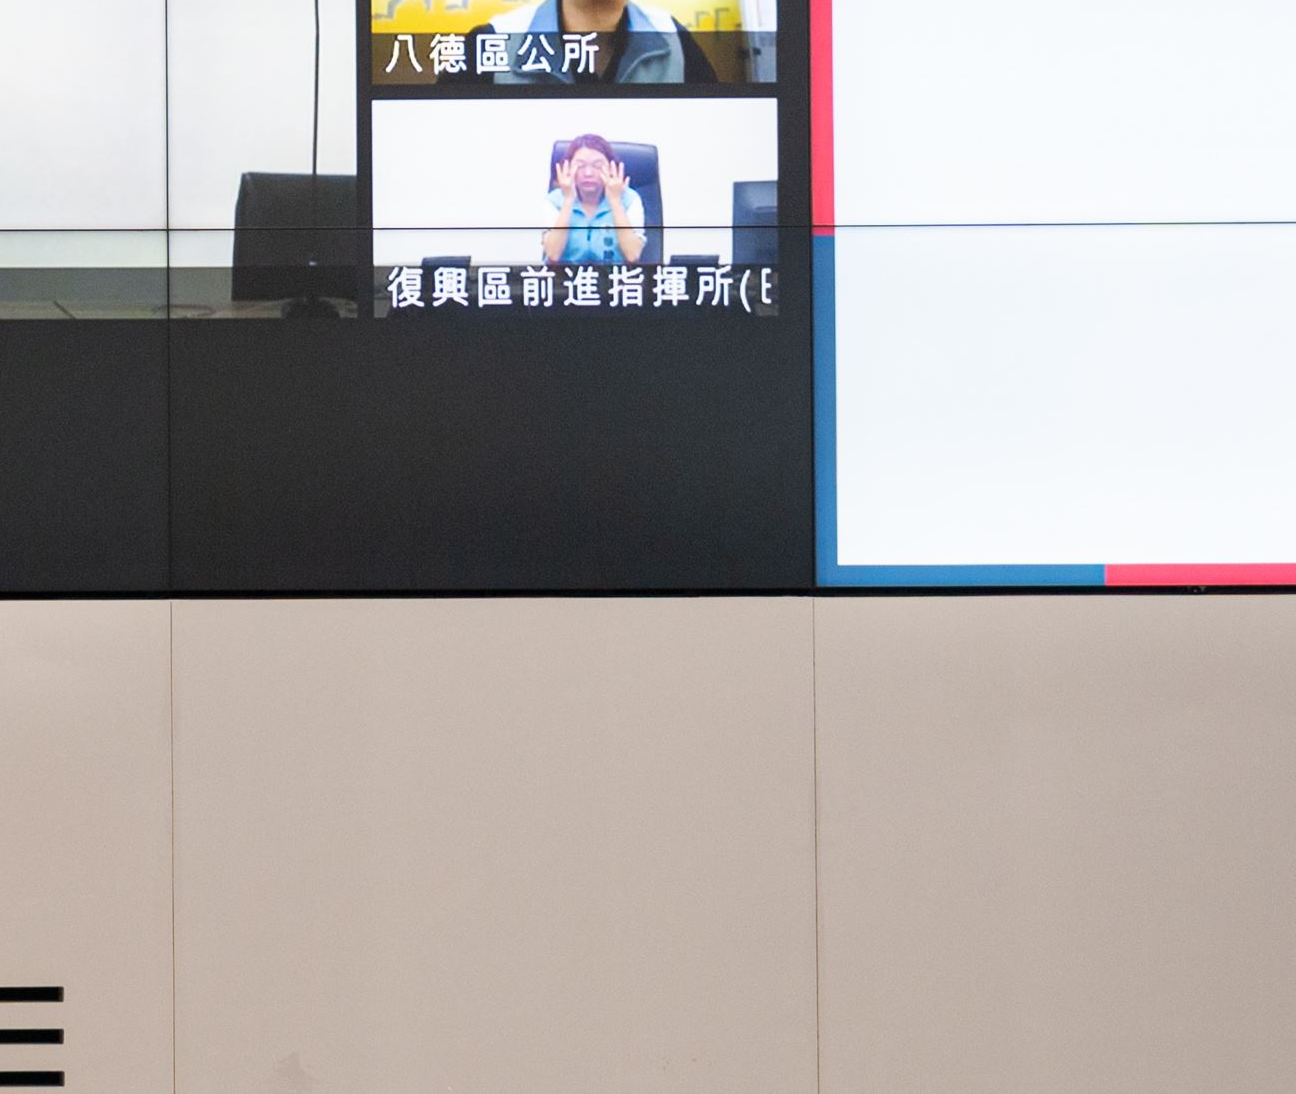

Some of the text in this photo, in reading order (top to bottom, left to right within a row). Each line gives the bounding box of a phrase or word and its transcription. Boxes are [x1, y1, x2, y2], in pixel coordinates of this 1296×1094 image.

[385, 32, 600, 75] 八德區公所
